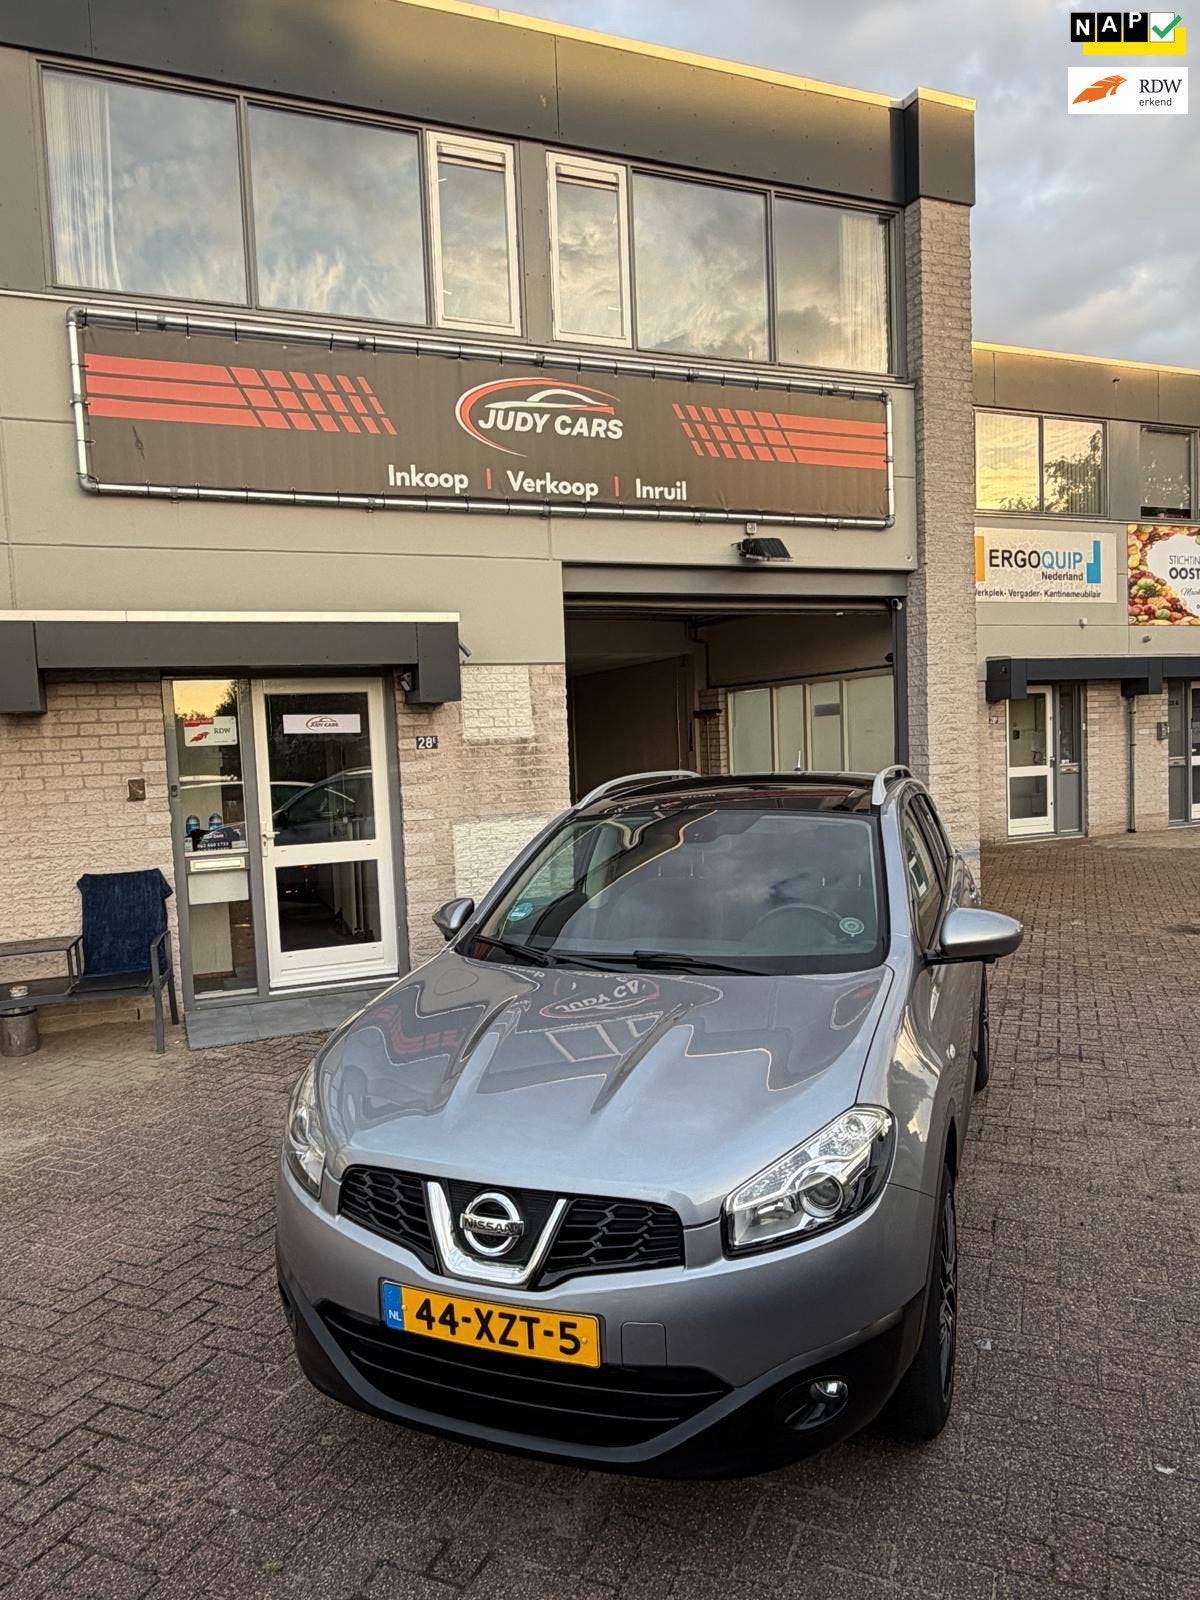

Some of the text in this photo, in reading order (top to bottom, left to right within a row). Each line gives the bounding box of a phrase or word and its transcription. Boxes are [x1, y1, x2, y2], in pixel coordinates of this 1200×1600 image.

[478, 408, 624, 439] JUDY CARS
[388, 464, 687, 500] Inkoop Verkoop Inruil
[988, 548, 1083, 569] ERGOQUIP
[1041, 571, 1084, 581] Nederland
[975, 588, 1006, 598] erkplek-
[464, 1218, 514, 1233] NISSAN
[388, 1309, 402, 1321] NL
[415, 1298, 581, 1355] 44-XZT-5
